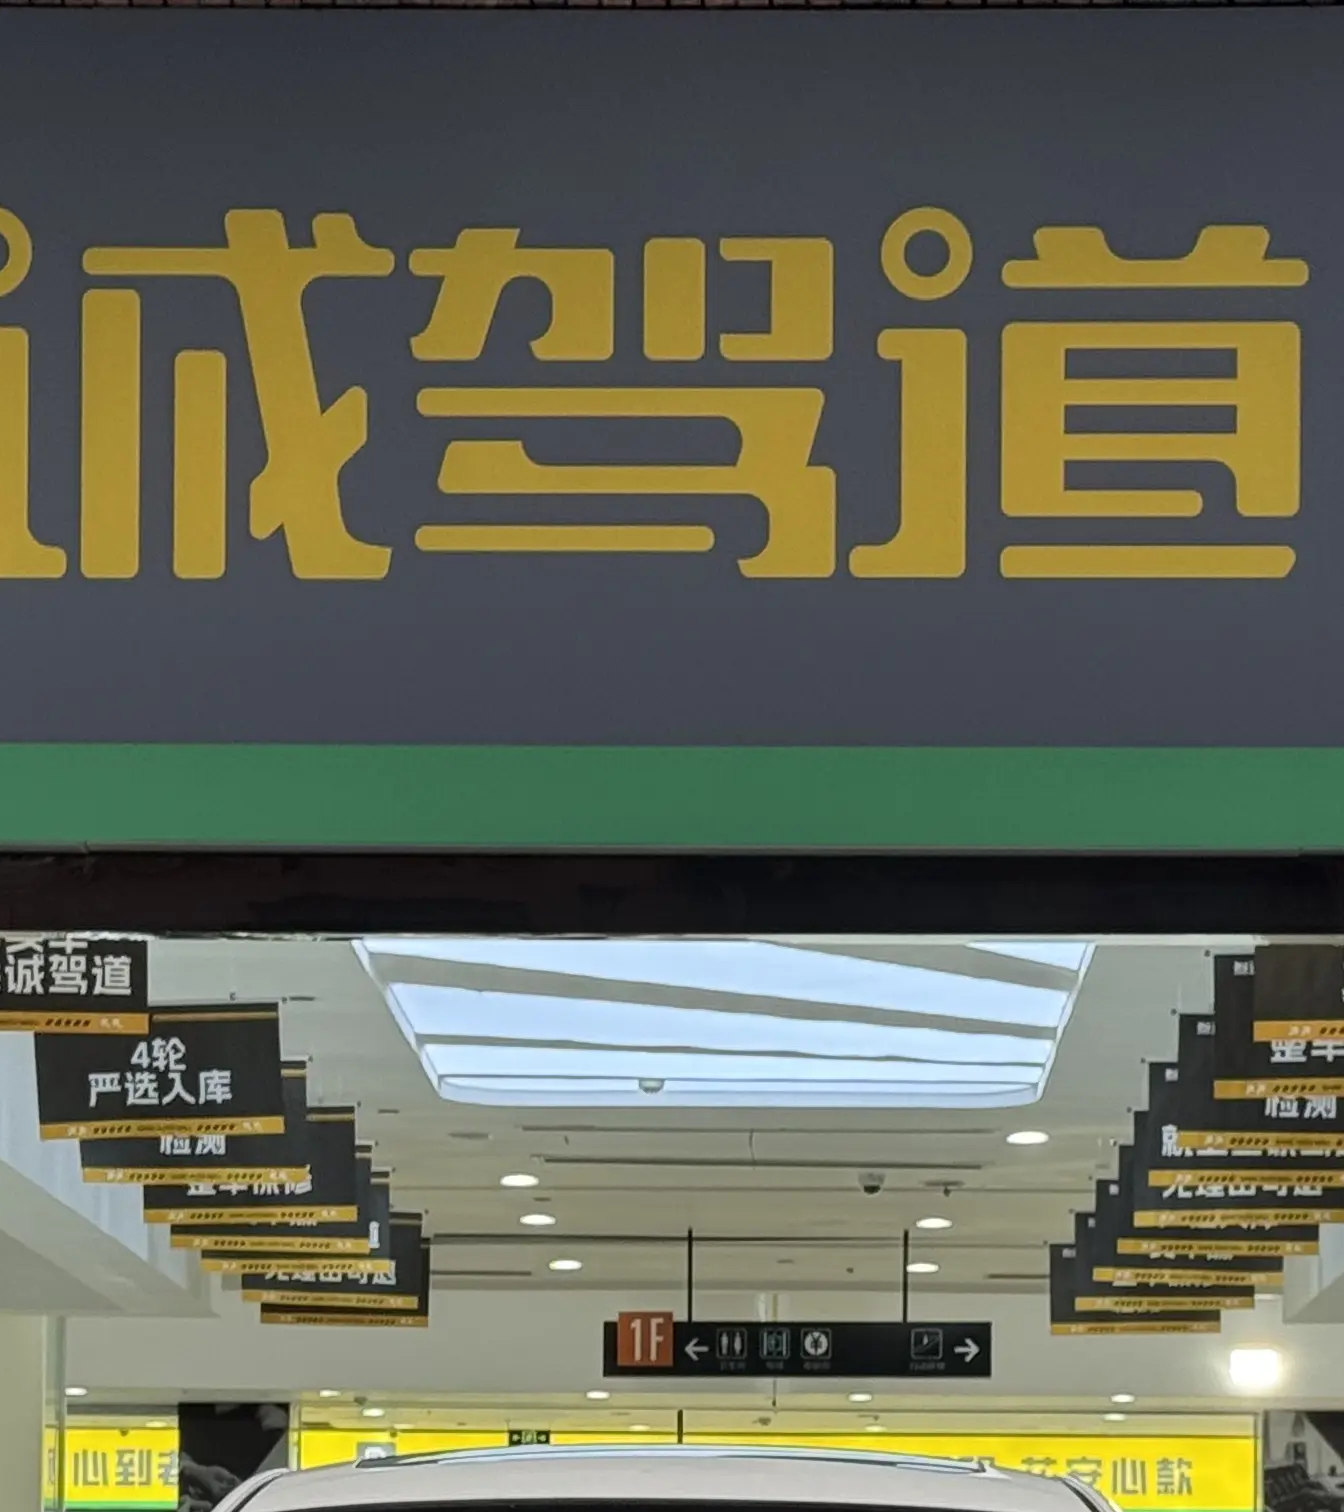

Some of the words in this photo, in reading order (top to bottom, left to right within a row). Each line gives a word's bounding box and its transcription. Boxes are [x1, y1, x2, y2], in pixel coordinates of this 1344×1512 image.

[129, 1036, 188, 1072] 4轮
[87, 1068, 234, 1108] 严选入库
[629, 1318, 665, 1363] 1F
